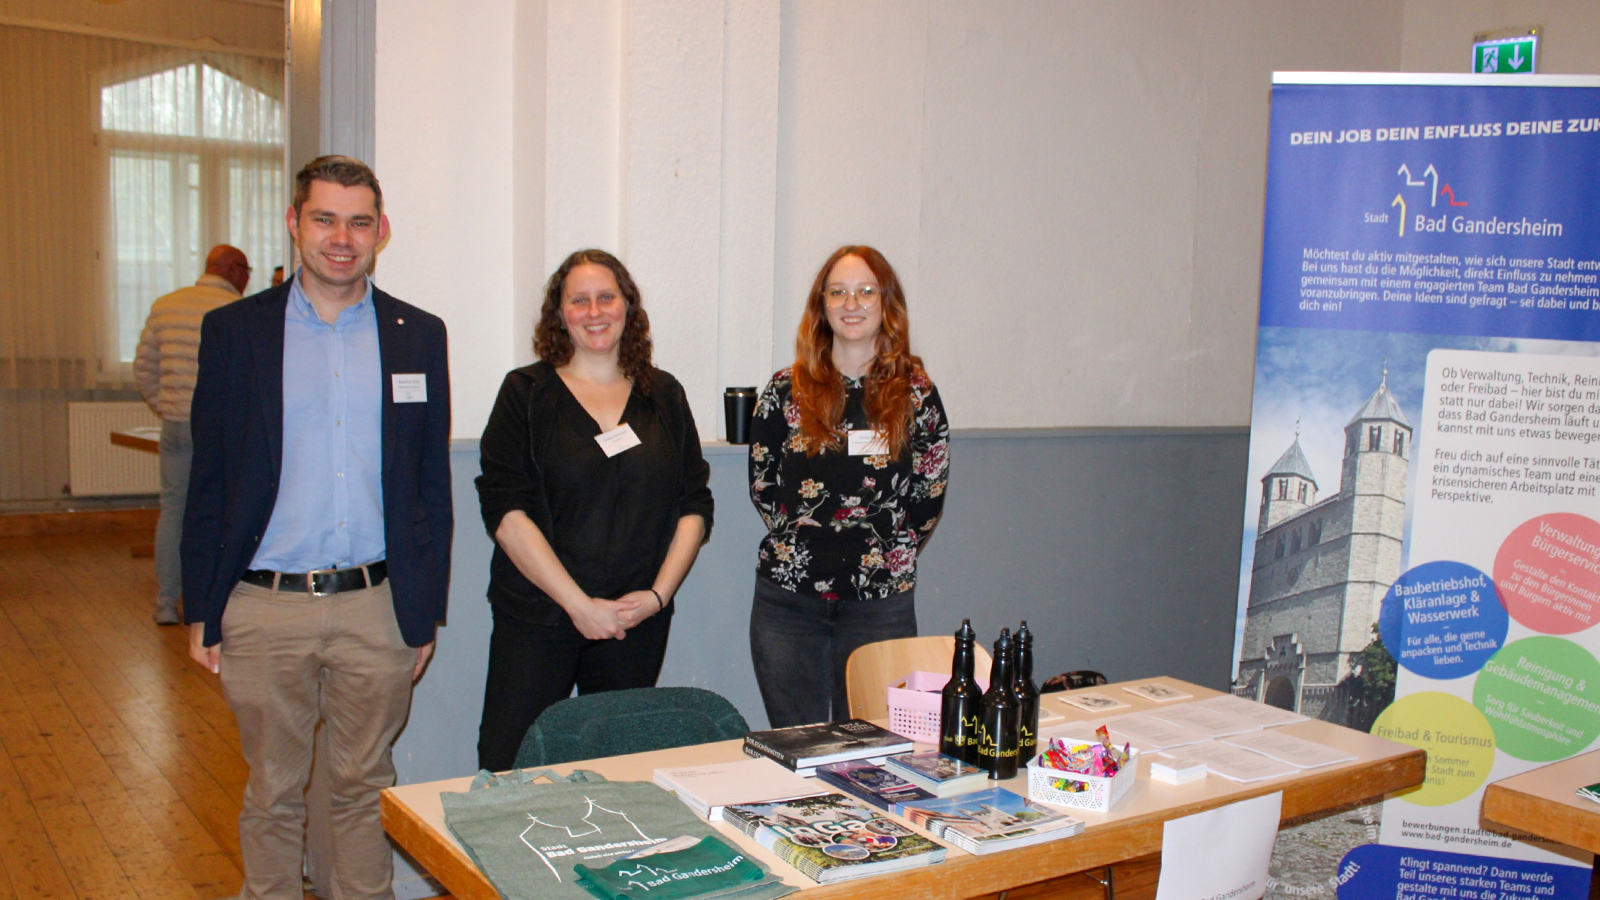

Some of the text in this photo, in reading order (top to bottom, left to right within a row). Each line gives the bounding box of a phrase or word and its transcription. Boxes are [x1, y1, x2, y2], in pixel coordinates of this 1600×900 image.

[1290, 131, 1332, 145] DEIN
[1336, 129, 1371, 143] JOB
[1376, 127, 1419, 141] DEIN
[1424, 123, 1502, 139] ENFLUSS
[1506, 120, 1563, 135] DEINE
[1364, 212, 1563, 236] Stadt Bad Gandersheim
[1303, 248, 1350, 260] Möchtest
[1352, 250, 1365, 260] du
[1368, 251, 1393, 262] aktiv
[1396, 252, 1461, 265] mitgestalten,
[1465, 255, 1483, 266] wie
[1486, 255, 1506, 266] sich
[1509, 258, 1544, 268] unsere
[1547, 257, 1575, 270] Stadt
[1302, 261, 1597, 283] Bei uns hast du die Möglichkeit, direkt Einfluss zu nehmen
[1301, 275, 1599, 297] gemeinsam mit einem engagierten Team Bad Gandersheim
[1299, 300, 1342, 311] dich ein!
[1300, 288, 1589, 310] voranzubringen. Deine Ideen sind gefragt sei dabei und
[1442, 367, 1458, 379] Ob
[1460, 368, 1524, 385] Verwaltung,
[1528, 372, 1570, 386] Technik,
[1441, 382, 1465, 393] oder
[1468, 383, 1508, 395] Freibad
[1521, 385, 1543, 398] hier
[1546, 388, 1566, 398] bist
[1568, 388, 1582, 400] du
[1439, 396, 1464, 407] statt
[1467, 398, 1485, 407] nur
[1489, 398, 1522, 410] dabei!
[1526, 400, 1545, 411] Wir
[1548, 403, 1584, 415] sorgen
[1438, 408, 1462, 420] dass
[1466, 410, 1486, 422] Bad
[1490, 411, 1560, 426] Gandersheim
[1564, 414, 1590, 428] läuft
[1437, 421, 1551, 439] kannst mit uns etwas
[1435, 449, 1457, 460] Freu
[1460, 450, 1482, 462] dich
[1486, 452, 1504, 463] auf
[1506, 453, 1530, 465] eine
[1532, 455, 1580, 468] sinnvolle
[1433, 462, 1449, 473] ein
[1452, 463, 1521, 478] dynamisches
[1524, 468, 1552, 480] Team
[1555, 471, 1576, 482] und
[1431, 489, 1493, 503] Perspektive.
[1432, 475, 1596, 497] krisensicheren Arbeitsplatz mit
[1395, 574, 1487, 597] Baubetriebshof,
[1513, 559, 1600, 604] Gestalte den Kontakt
[1404, 590, 1480, 610] Kläranlage &
[1500, 579, 1591, 625] und Bürgern aktiv mit.
[1510, 572, 1592, 612] zu den Bürgerinnen
[1407, 605, 1479, 624] Wasserwerk
[1401, 639, 1498, 658] anpacken und Technik
[1407, 631, 1486, 646] Für alle, die gerne
[1434, 656, 1463, 665] lieben.
[1517, 656, 1586, 691] Reinigung &
[1485, 694, 1584, 739] Sorg für Sauberkeit und
[1485, 705, 1572, 746] Wohlfühlatmosphäre
[1377, 726, 1492, 748] Freibad & Tourismus
[1431, 765, 1454, 775] Stadt
[1434, 755, 1470, 766] Sommer
[540, 844, 568, 852] Stadt
[545, 848, 575, 858] Bad
[576, 838, 667, 853] Gandersheim
[1401, 830, 1512, 848] www.bad-gandersheim.de
[647, 855, 743, 888] Bad Gandersheim
[1284, 860, 1361, 896] unsere Stadt!
[1400, 857, 1553, 883] Klingt spannend? Dann werde
[1397, 883, 1438, 894] gestalte
[1440, 886, 1457, 896] mit
[1460, 890, 1478, 899] uns
[1480, 890, 1496, 900] die
[1400, 868, 1555, 895] Teil unseres starken Teams und
